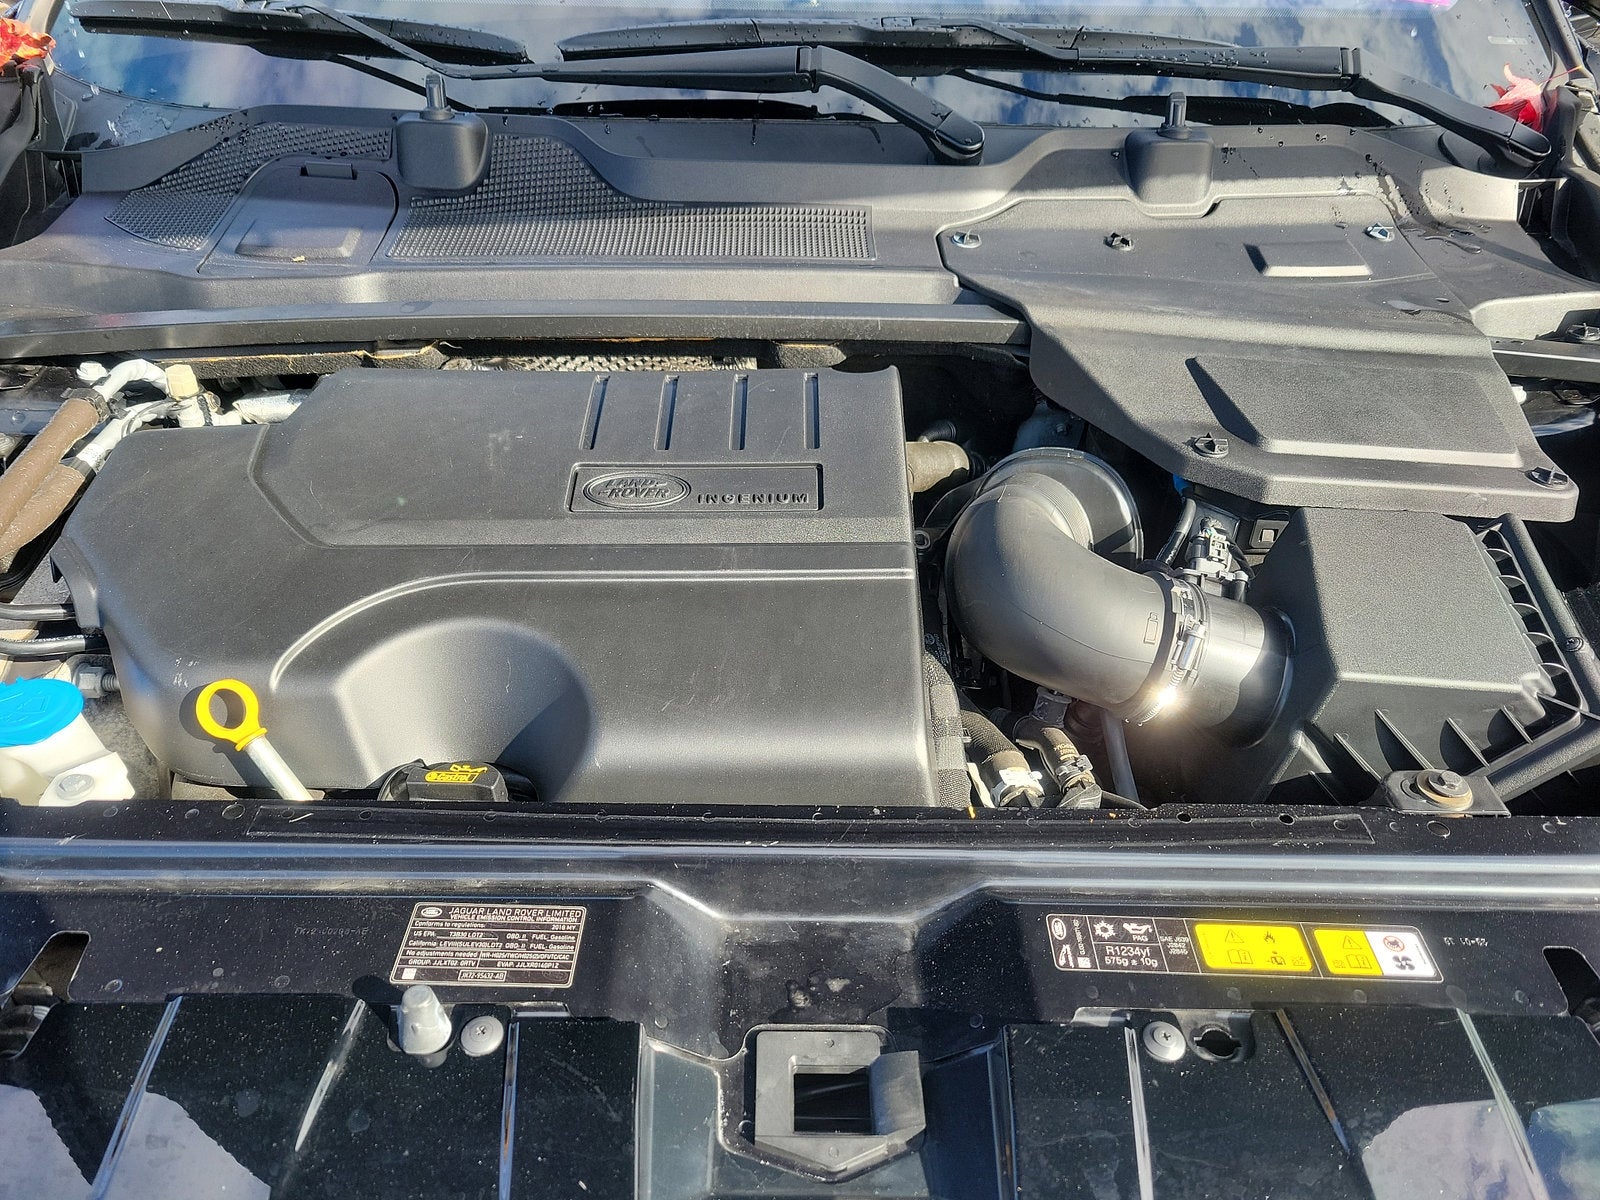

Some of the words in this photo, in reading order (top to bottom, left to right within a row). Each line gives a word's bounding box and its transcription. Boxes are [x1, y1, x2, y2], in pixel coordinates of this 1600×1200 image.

[607, 487, 671, 499] ROVER
[697, 493, 810, 504] INGENIUM
[437, 773, 470, 781] Castrol
[1105, 946, 1151, 958] R1234yf
[1105, 956, 1128, 966] 575g
[1140, 958, 1158, 968] 10g
